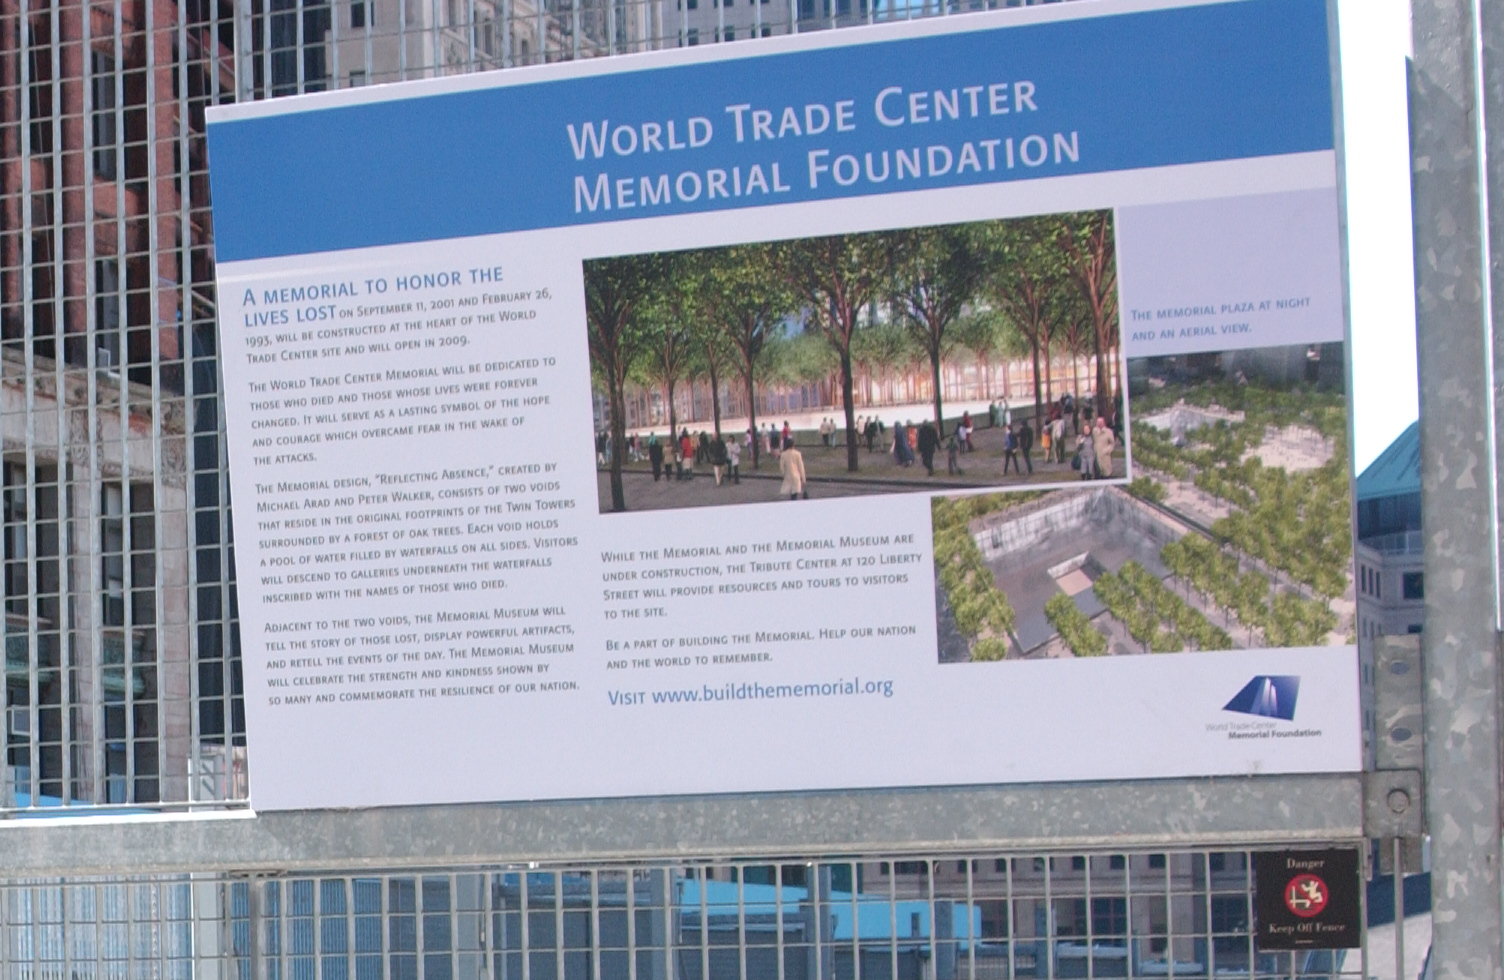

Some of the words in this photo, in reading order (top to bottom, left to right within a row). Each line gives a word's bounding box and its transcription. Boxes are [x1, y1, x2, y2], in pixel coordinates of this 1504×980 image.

[566, 117, 714, 161] WORLD
[725, 99, 857, 142] TRADE
[874, 80, 1039, 127] CENTER
[573, 161, 791, 214] MEMORIAL
[808, 130, 1081, 190] FOUNDATION
[242, 288, 256, 306] A
[263, 281, 358, 304] MEMORIAL
[364, 277, 387, 294] TO
[396, 270, 461, 291] HONOR
[468, 266, 503, 283] THE
[244, 308, 289, 327] LIVES
[296, 304, 336, 322] LOST
[338, 308, 353, 318] ON
[356, 302, 412, 317] SEPTEMBER
[430, 298, 454, 309] 2001
[457, 296, 478, 307] AND
[481, 291, 531, 304] FEBRUARY
[1130, 308, 1151, 321] THE
[1156, 305, 1216, 319] MEMORIAL
[1220, 301, 1254, 313] PLAZA
[1258, 299, 1271, 310] AT
[1275, 296, 1310, 309] NIGHT
[275, 332, 297, 343] WILL
[301, 330, 313, 340] BE
[316, 323, 386, 339] CONSTRUCTED
[389, 322, 400, 332] AT
[404, 320, 422, 330] THE
[426, 316, 456, 328] HEART
[460, 315, 472, 325] OF
[476, 313, 495, 324] THE
[498, 309, 536, 322] WORLD
[1131, 330, 1155, 342] AND
[1159, 328, 1175, 339] AN
[1179, 325, 1216, 337] AERIAL
[1220, 322, 1251, 334] VIEW.
[245, 352, 276, 364] TRADE
[280, 349, 318, 361] CENTER
[321, 346, 341, 357] SITE
[344, 344, 365, 355] AND
[367, 342, 390, 353] WILL
[394, 339, 420, 350] OPEN
[424, 338, 435, 347] IN
[248, 381, 266, 392] THE
[269, 379, 306, 390] WORLD
[309, 376, 340, 387] TRADE
[343, 372, 382, 384] CENTER
[385, 367, 438, 380] MEMORIAL
[441, 365, 465, 375] WILL
[468, 363, 480, 373] BE
[484, 358, 539, 372] DEDICATED
[542, 356, 556, 366] TO
[303, 414, 311, 425] IT
[315, 413, 337, 424] WILL
[340, 410, 369, 422] SERVE
[373, 409, 385, 419] AS
[388, 408, 395, 417] A
[398, 404, 437, 417] LASTING
[440, 401, 480, 413] SYMBOL
[483, 399, 496, 409] OF
[500, 397, 518, 408] THE
[522, 394, 549, 406] HOPE
[254, 482, 273, 494] THE
[277, 480, 329, 492] MEMORIAL
[497, 463, 540, 475] CREATED
[544, 462, 556, 472] BY
[257, 520, 280, 530] THAT
[284, 517, 317, 529] RESIDE
[320, 517, 331, 526] IN
[334, 514, 353, 525] THE
[356, 511, 401, 523] ORIGINAL
[405, 506, 464, 519] FOOTPRINTS
[467, 505, 480, 515] OF
[483, 503, 502, 514] THE
[505, 501, 531, 512] TWIN
[535, 498, 575, 510] TOWERS
[600, 551, 634, 563] WHILE
[639, 549, 658, 560] THE
[663, 546, 721, 558] MEMORIAL
[725, 544, 747, 554] AND
[751, 542, 771, 553] THE
[776, 538, 835, 551] MEMORIAL
[839, 535, 889, 547] MUSEUM
[893, 533, 913, 544] ARE
[601, 570, 637, 582] UNDER
[726, 563, 745, 573] THE
[749, 560, 791, 572] TRIBUTE
[795, 558, 837, 570] CENTER
[840, 557, 852, 567] AT
[856, 555, 875, 566] 120
[879, 553, 922, 565] LIBERTY
[265, 641, 285, 651] TELL
[289, 639, 307, 649] THE
[310, 638, 340, 648] STORY
[343, 636, 356, 646] OF
[359, 634, 390, 645] THOSE
[423, 631, 462, 642] DISPLAY
[465, 627, 518, 639] POWERFUL
[605, 639, 619, 651] BE
[623, 640, 630, 649] A
[633, 638, 657, 649] PART
[661, 637, 674, 648] OF
[678, 635, 728, 647] BUILDING
[731, 633, 750, 643] THE
[818, 628, 846, 639] HELP
[850, 627, 873, 638] OUR
[877, 625, 916, 636] NATION
[267, 677, 289, 687] WILL
[292, 674, 343, 686] CELEBRATE
[347, 673, 365, 682] THE
[368, 670, 417, 681] STRENGTH
[421, 669, 441, 678] AND
[445, 666, 493, 677] KINDNESS
[496, 664, 533, 675] SHOWN
[536, 663, 549, 672] BY
[607, 689, 645, 705] VISIT
[651, 676, 893, 703] www.buildthememorial.org
[1229, 730, 1270, 740] Memorial
[1271, 728, 1322, 738] Foundation
[1287, 858, 1325, 870] Danger
[1269, 923, 1294, 934] Keep
[1297, 922, 1313, 932] Off
[1315, 922, 1346, 932] Fence
